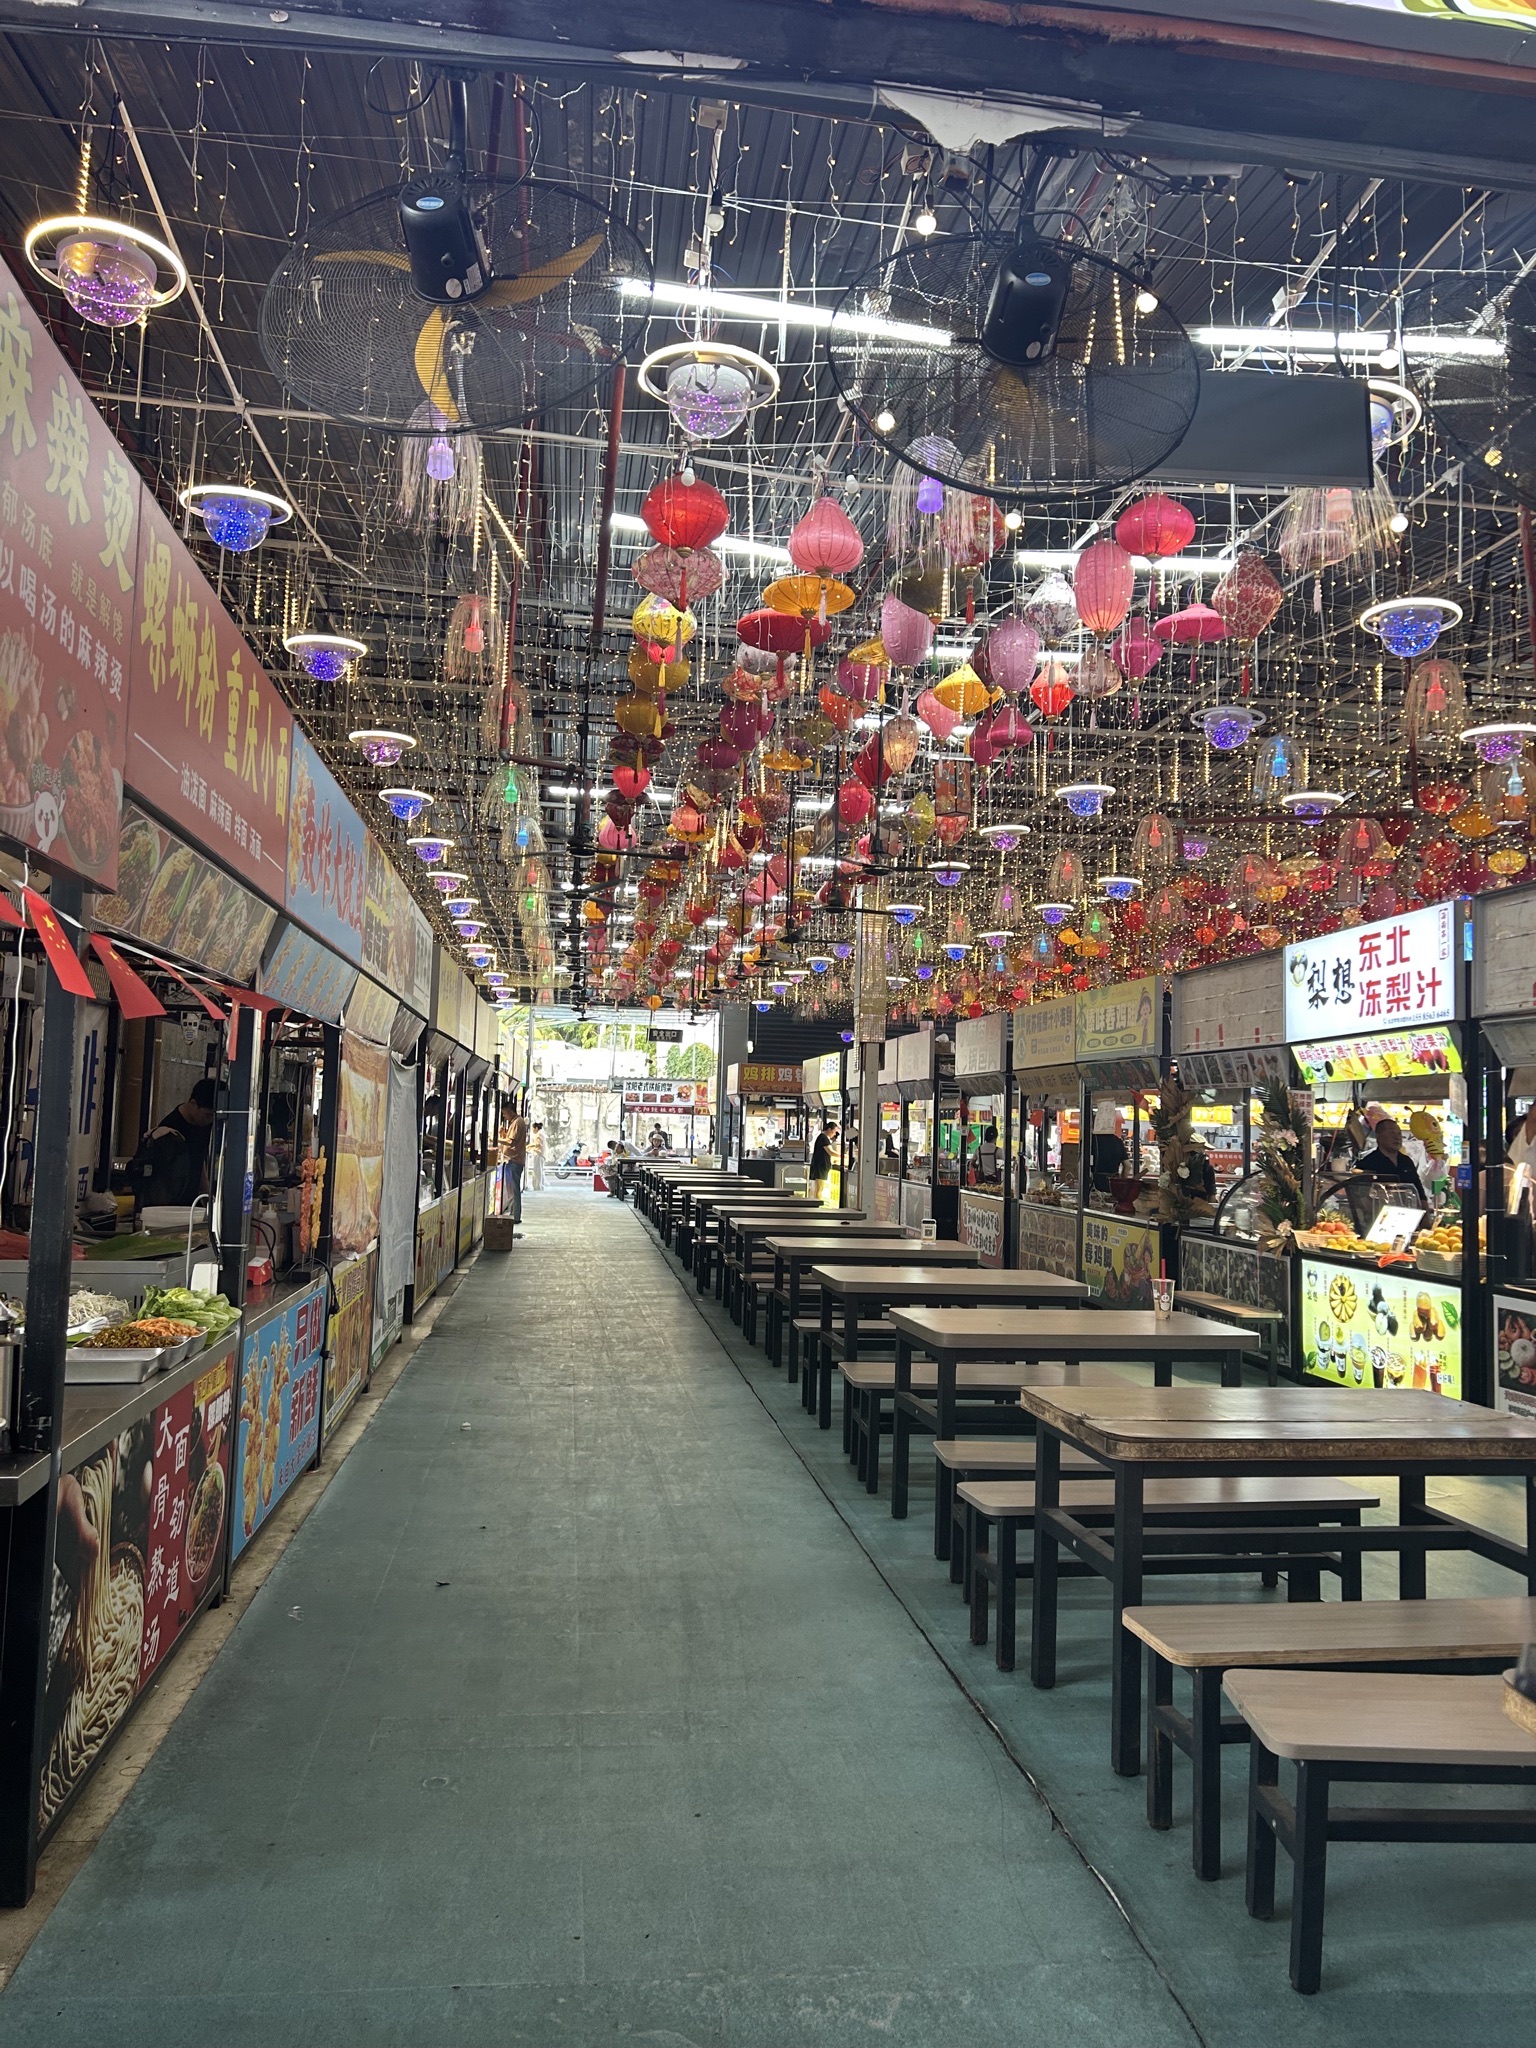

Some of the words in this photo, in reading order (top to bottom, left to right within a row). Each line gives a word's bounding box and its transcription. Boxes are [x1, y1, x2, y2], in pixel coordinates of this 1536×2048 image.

[71, 559, 123, 646] 就是解馋
[141, 533, 219, 744] 螺蛳粉
[224, 648, 288, 827] 重庆小面
[209, 788, 233, 836] 麻辣面
[1359, 924, 1410, 972] 东北
[1359, 967, 1442, 1018] 冻梨汁
[1353, 1040, 1381, 1058] 西瓜汁
[1380, 1037, 1406, 1054] 凤梨汁
[1409, 1032, 1447, 1050] 火龙果汁
[1086, 1222, 1108, 1242] 美味的
[293, 1292, 323, 1372] 只做
[289, 1359, 319, 1447] 新鲜
[144, 1406, 173, 1670] 大骨熬汤
[164, 1424, 190, 1609] 面劲道
